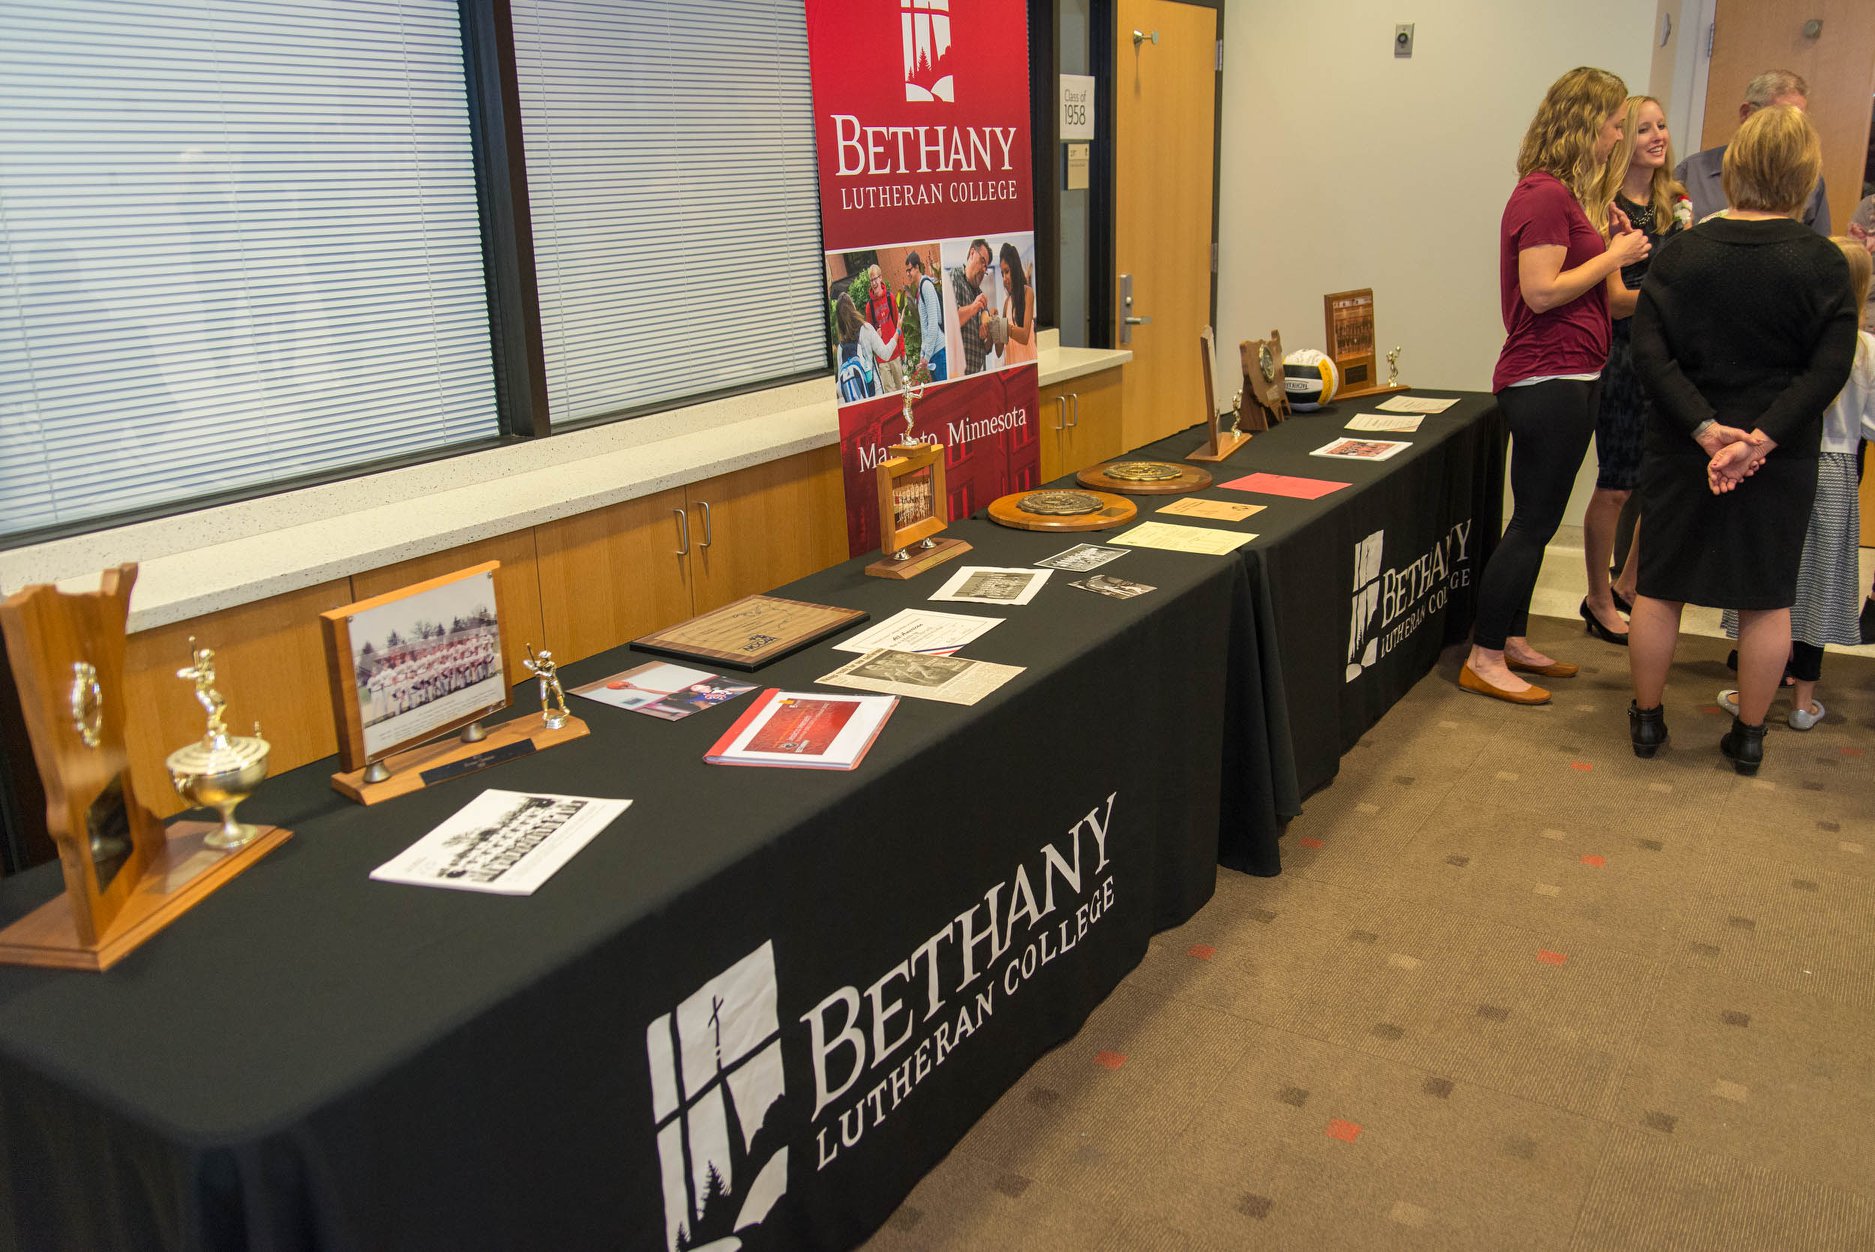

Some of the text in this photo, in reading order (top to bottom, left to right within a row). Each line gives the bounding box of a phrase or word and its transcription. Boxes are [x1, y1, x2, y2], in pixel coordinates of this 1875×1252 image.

[1064, 88, 1087, 103] Class of
[1064, 104, 1086, 126] 1958
[830, 114, 1017, 176] BETHANY
[840, 180, 1017, 210] LUTHERAN COLLEGE
[947, 406, 1027, 447] Minnesota
[1428, 568, 1471, 614] COLGE
[799, 791, 1118, 1123] BETHANY
[816, 875, 1115, 1172] LUTHERAN COLLEGE
